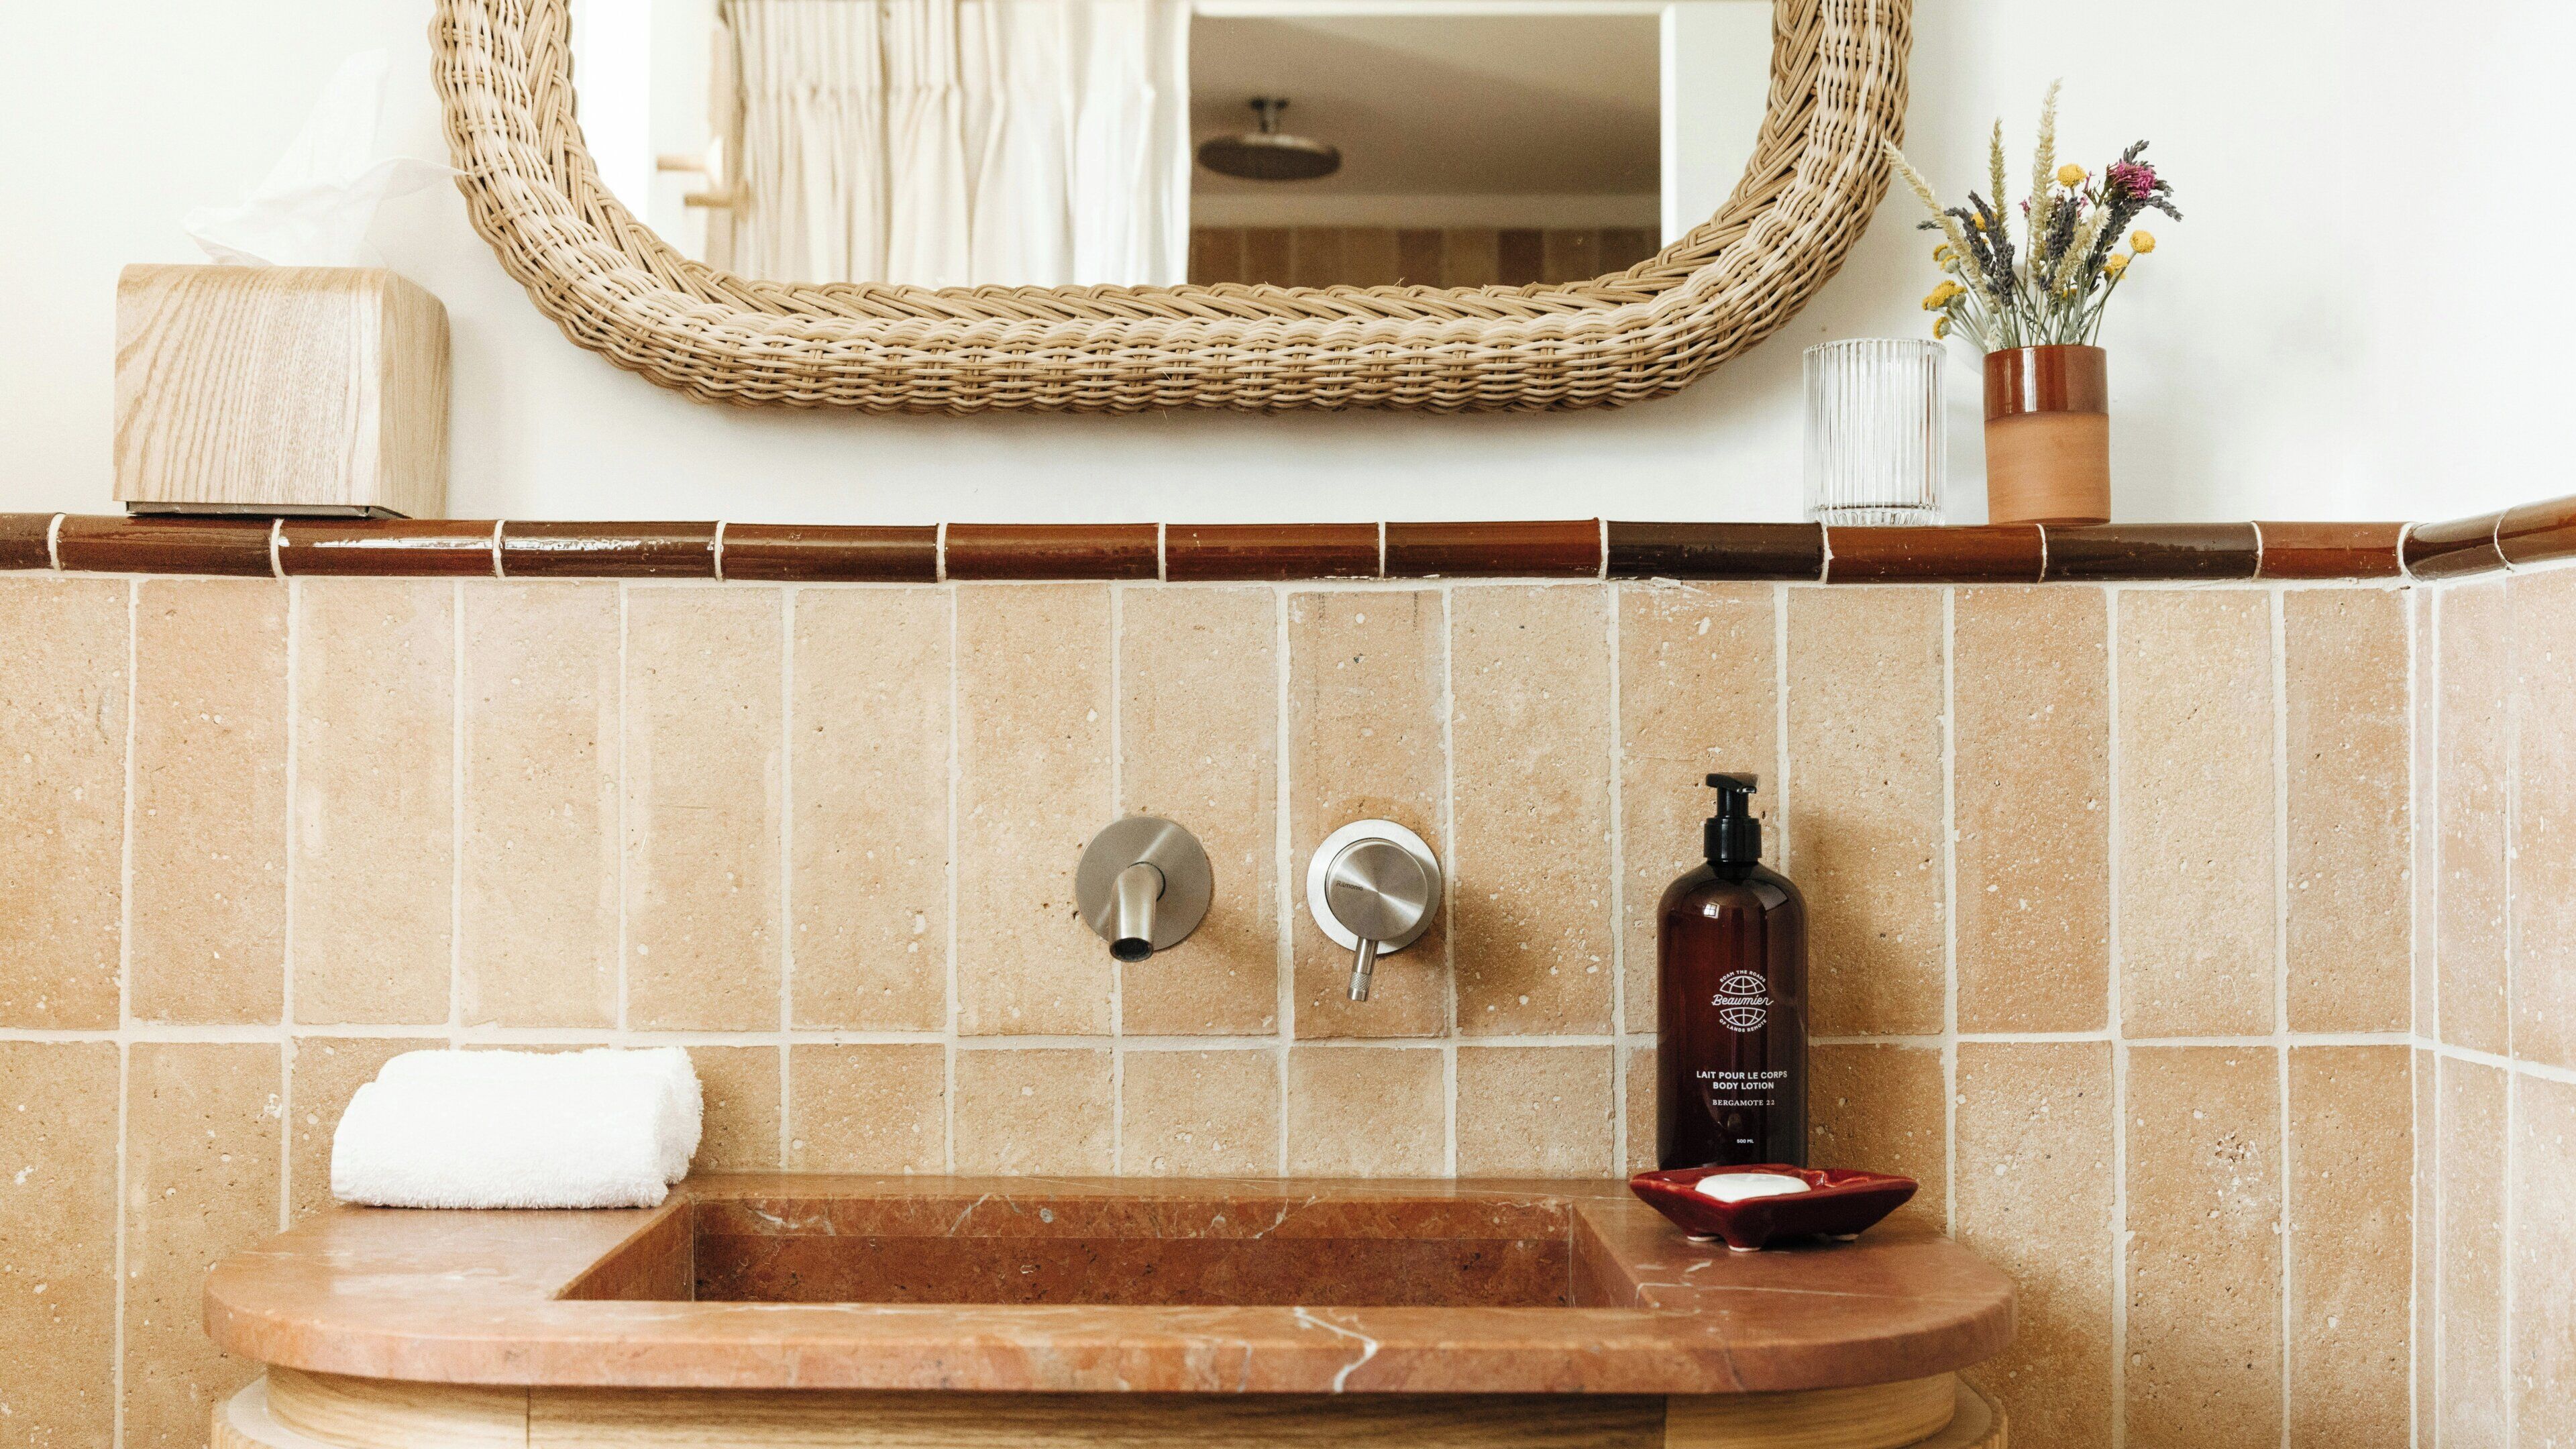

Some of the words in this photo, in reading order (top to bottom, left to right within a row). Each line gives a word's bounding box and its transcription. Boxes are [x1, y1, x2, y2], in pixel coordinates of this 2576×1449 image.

[1719, 971, 1735, 983] ROAM
[1749, 971, 1766, 983] ROADS
[1711, 994, 1774, 1006] Beaumier
[1727, 1024, 1746, 1032] LANDS
[1747, 1019, 1767, 1032] REMOTE
[1697, 1071, 1716, 1079] LAIT
[1719, 1071, 1746, 1079] POUR
[1760, 1071, 1788, 1079] CORPS
